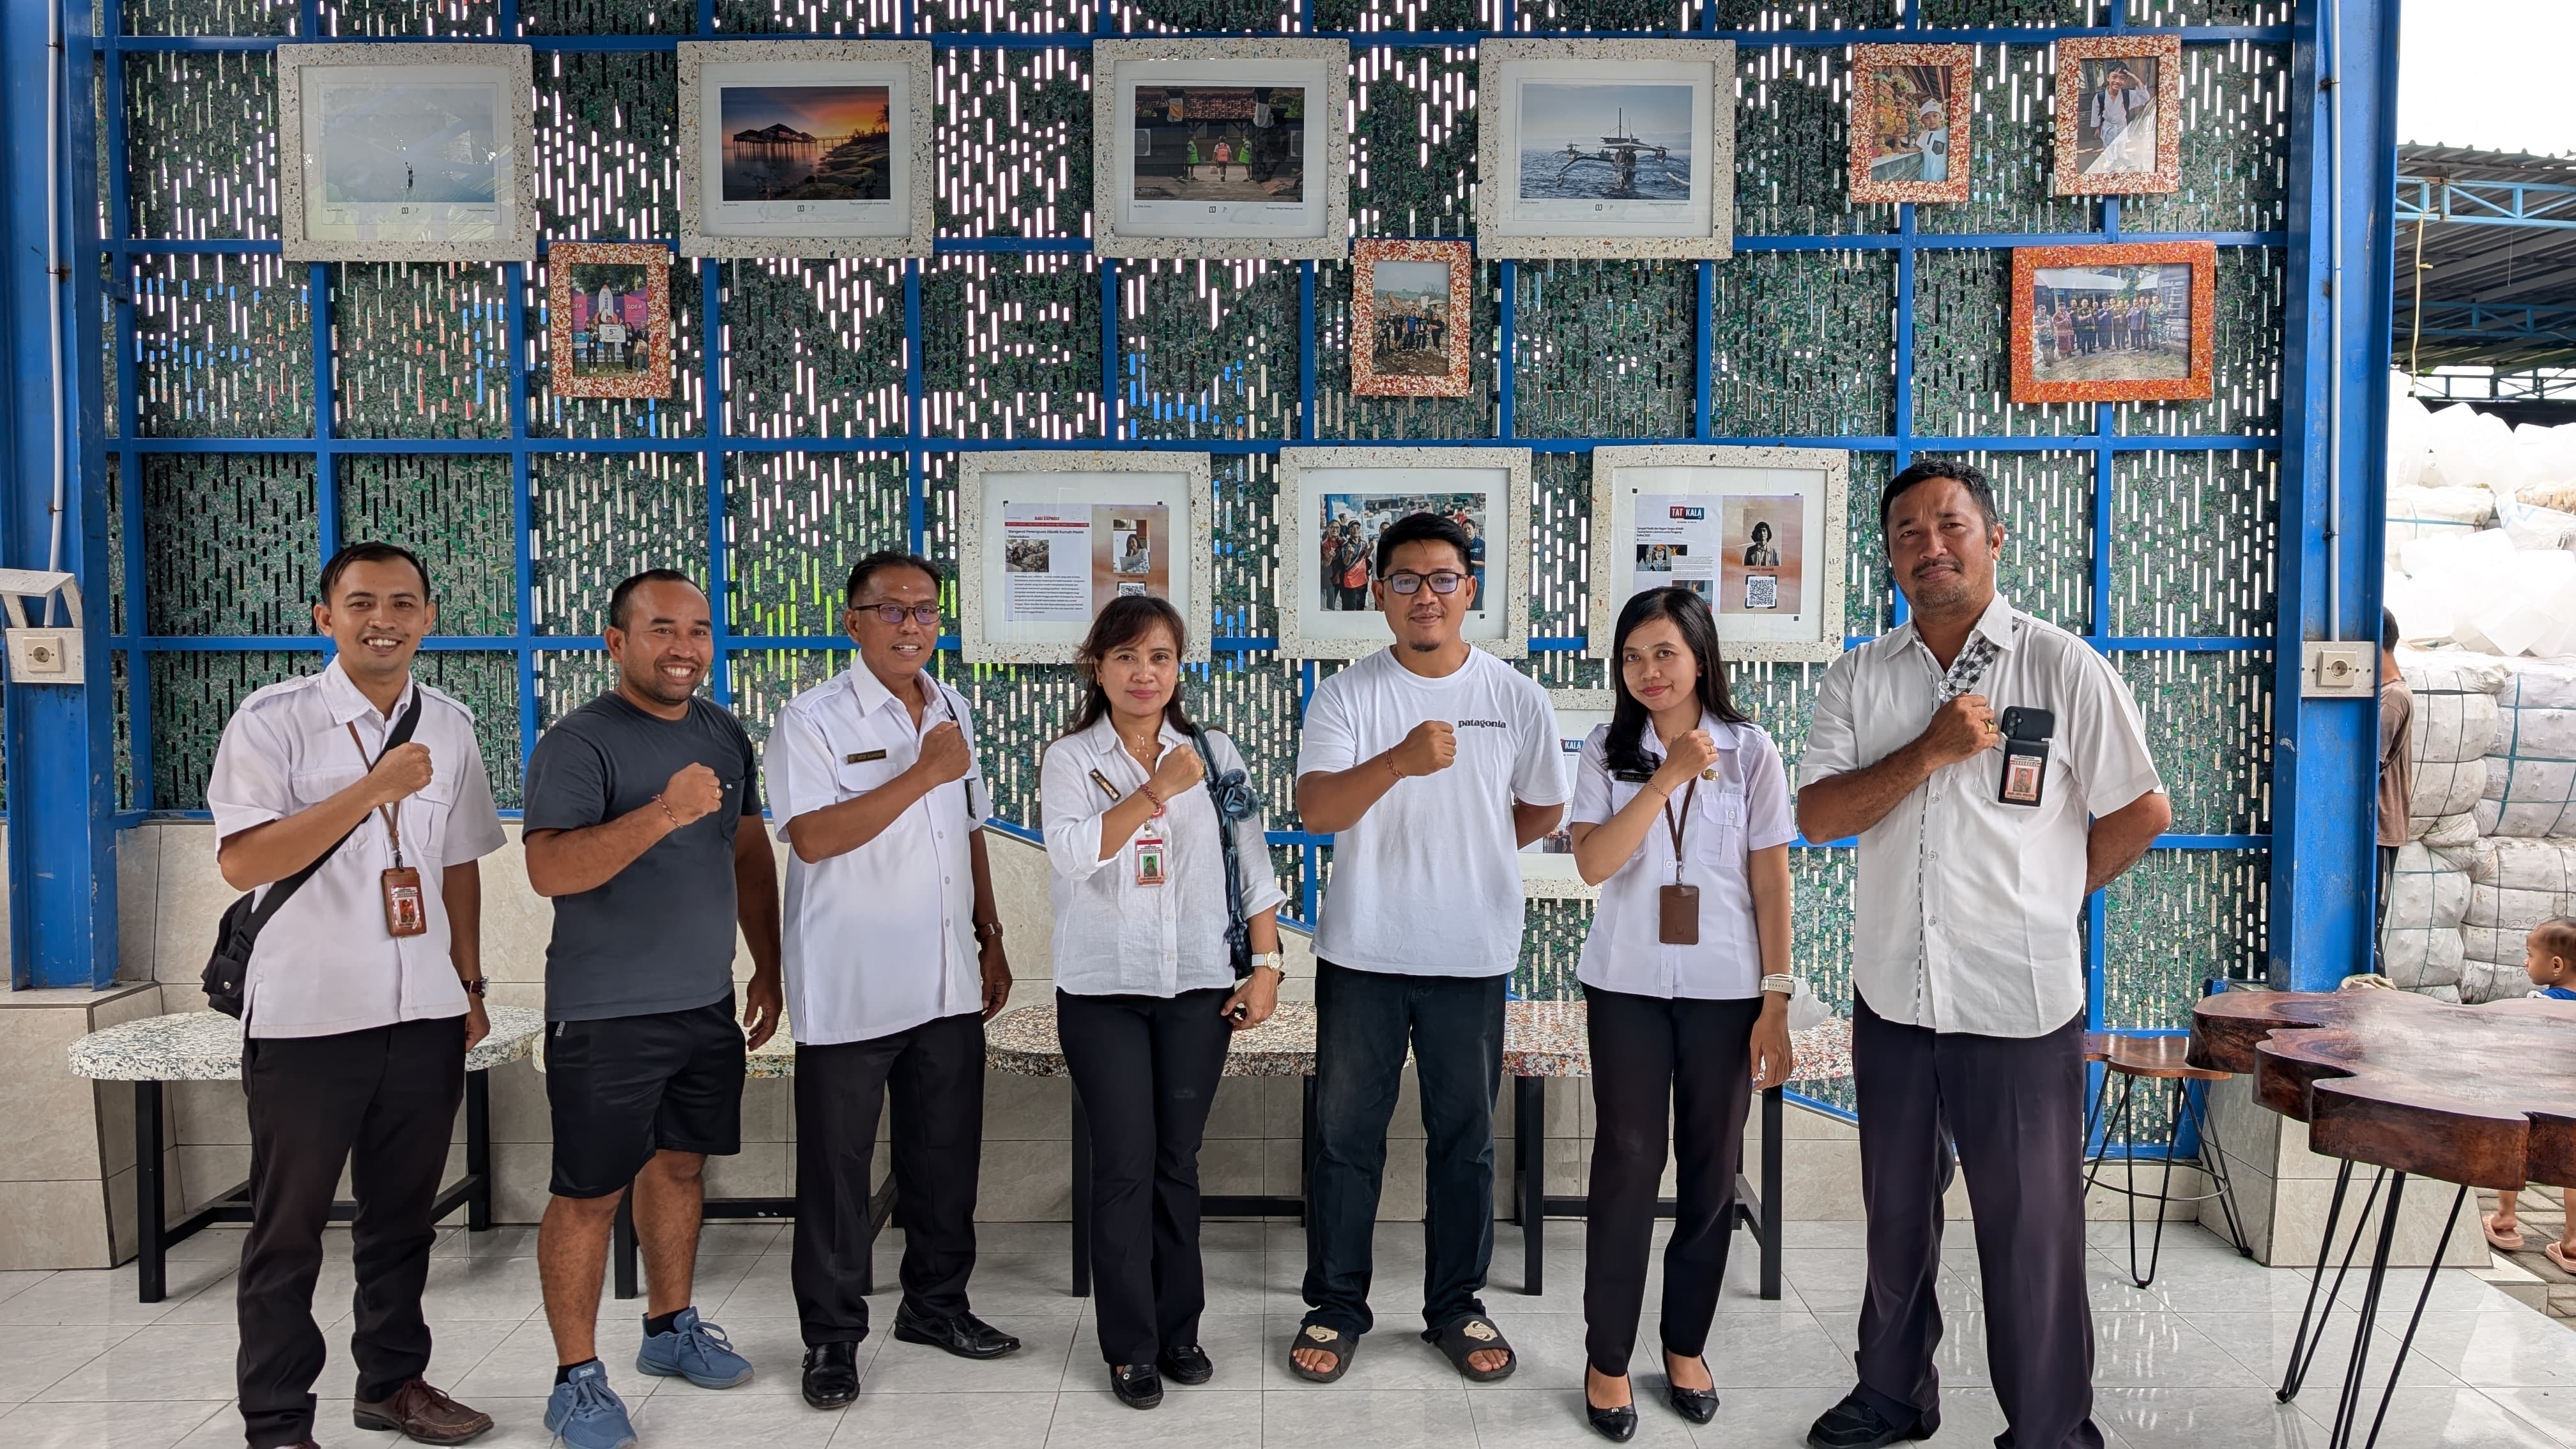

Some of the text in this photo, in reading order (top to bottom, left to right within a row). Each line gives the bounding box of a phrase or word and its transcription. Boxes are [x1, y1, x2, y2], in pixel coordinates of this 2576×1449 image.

[1671, 508, 1702, 517] TAT KALA
[1458, 719, 1506, 728] patagonia
[1565, 741, 1581, 749] KALA
